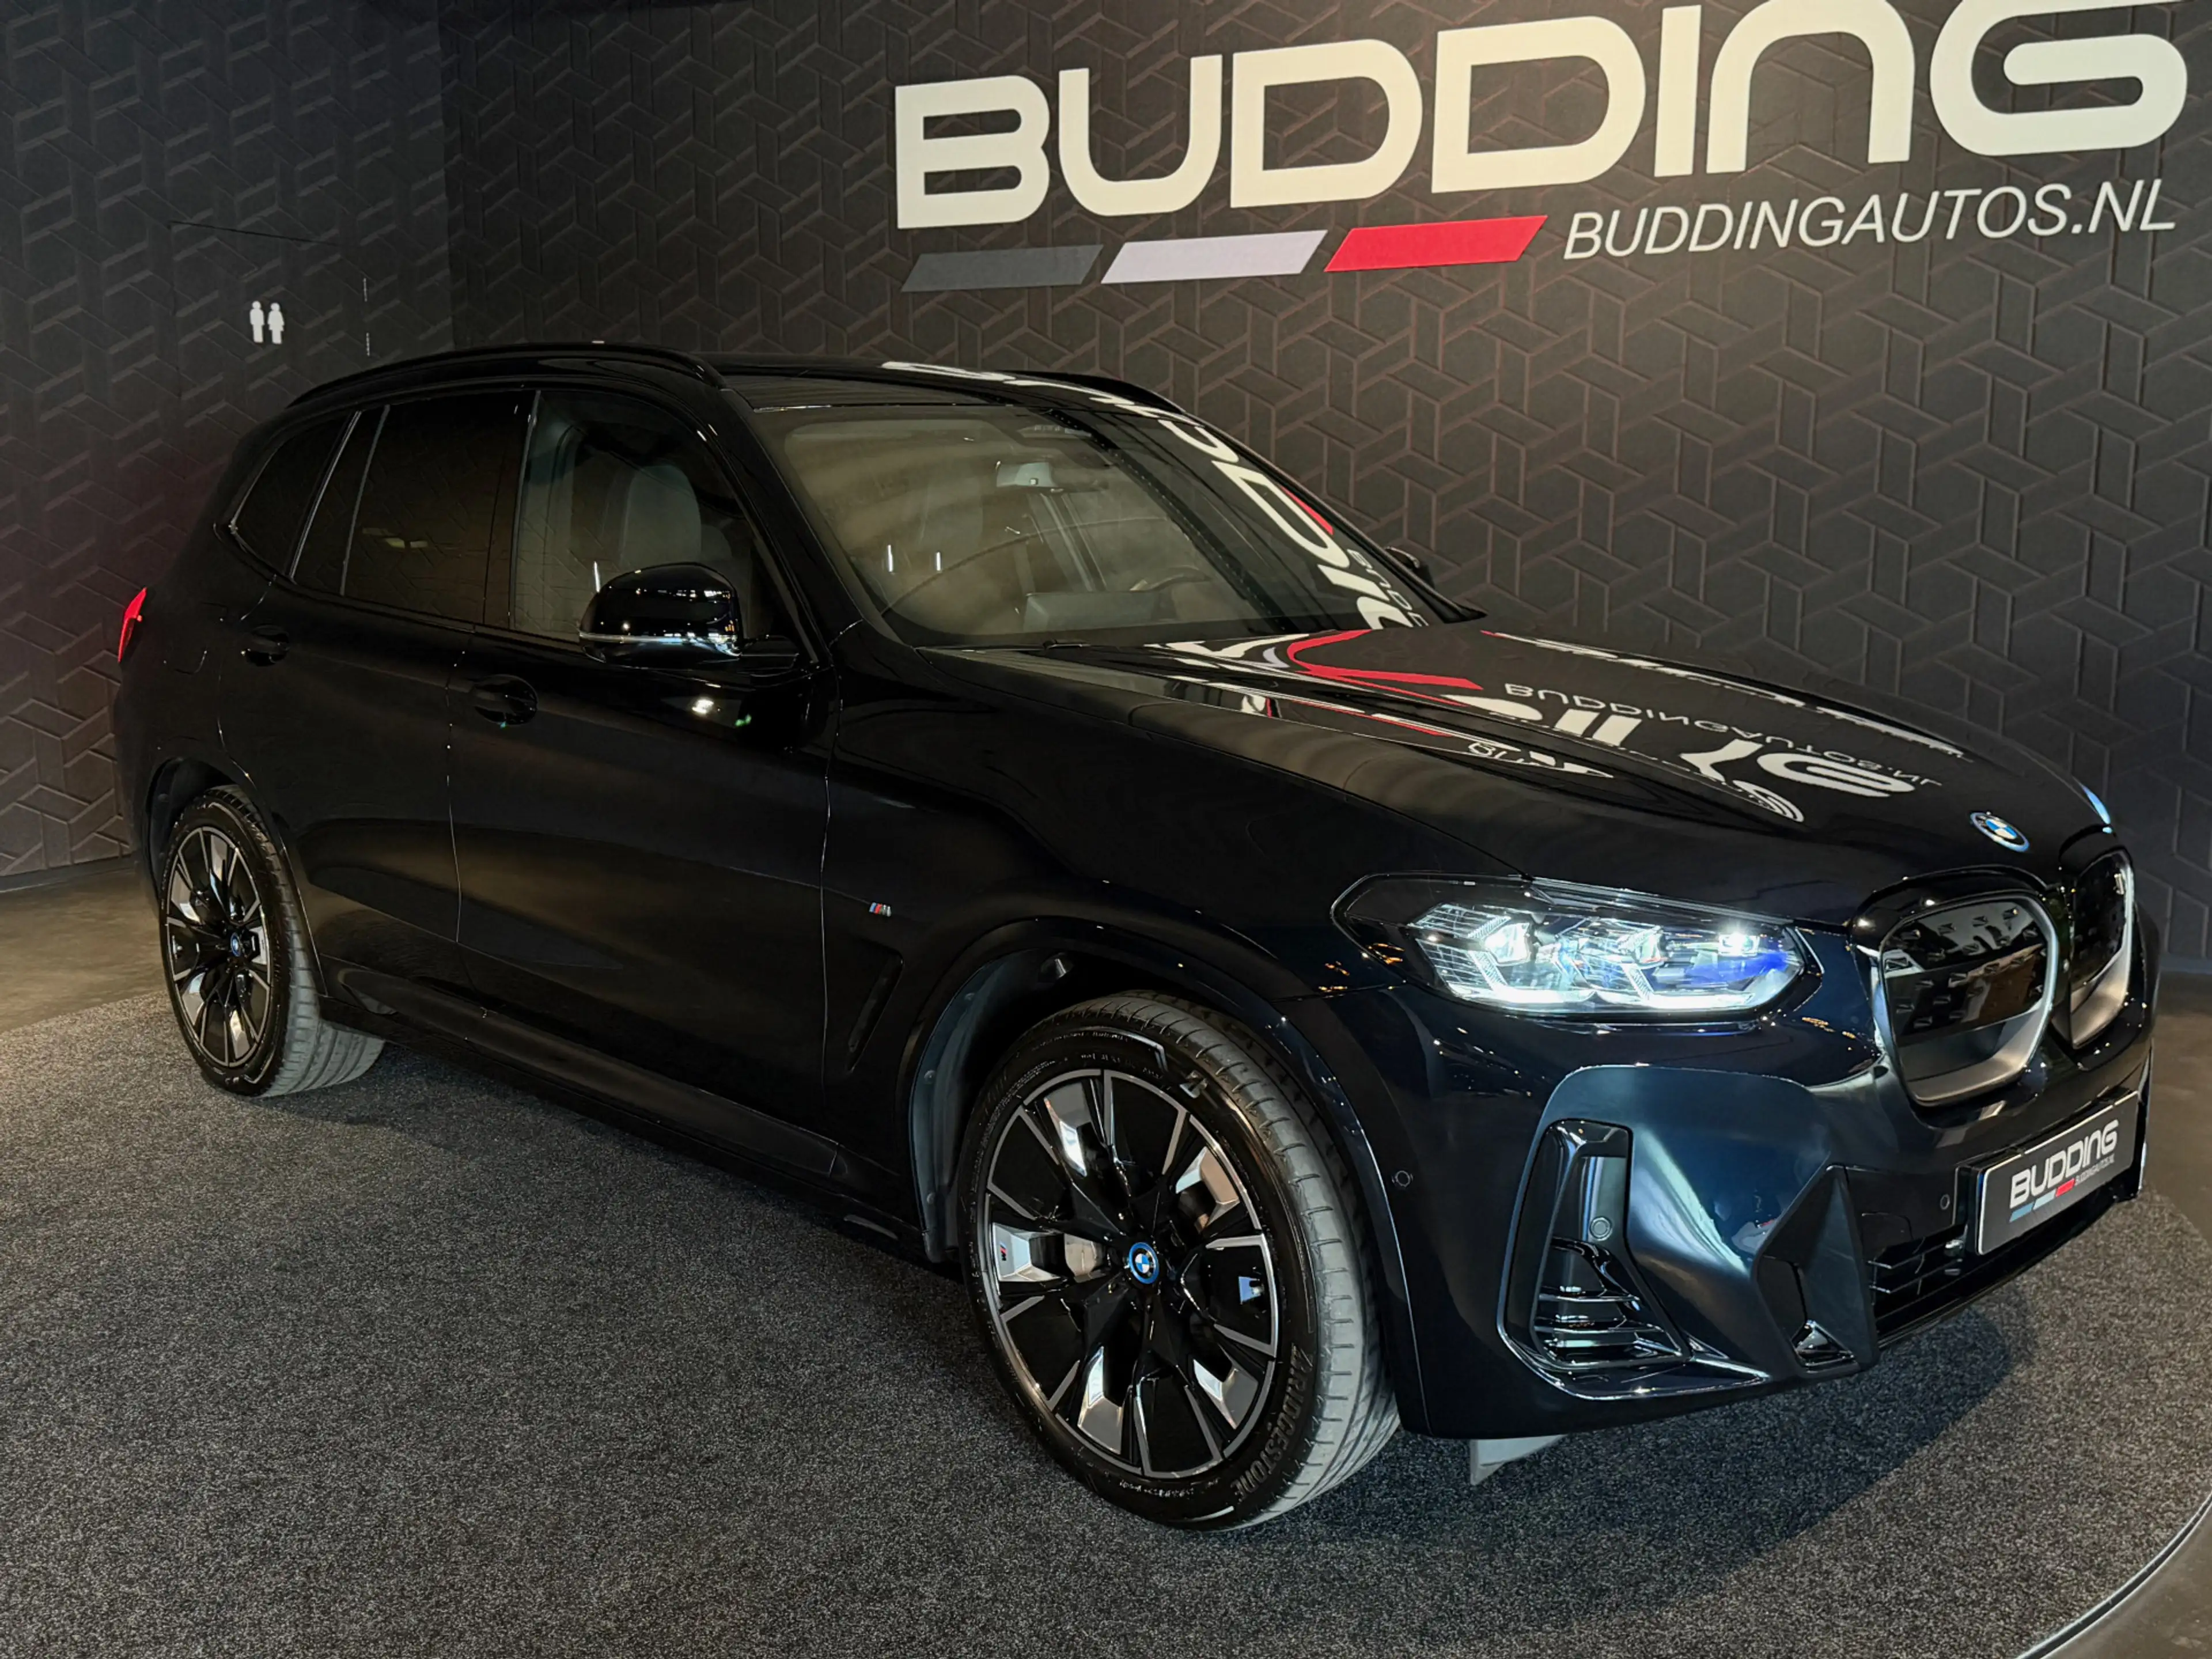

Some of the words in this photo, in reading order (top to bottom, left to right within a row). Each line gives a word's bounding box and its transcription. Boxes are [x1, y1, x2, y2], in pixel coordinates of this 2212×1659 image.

[895, 0, 2189, 229] BUDDING
[1563, 179, 2175, 260] BUDDINGAUTOS.NL
[2010, 1119, 2119, 1209] BUDDING
